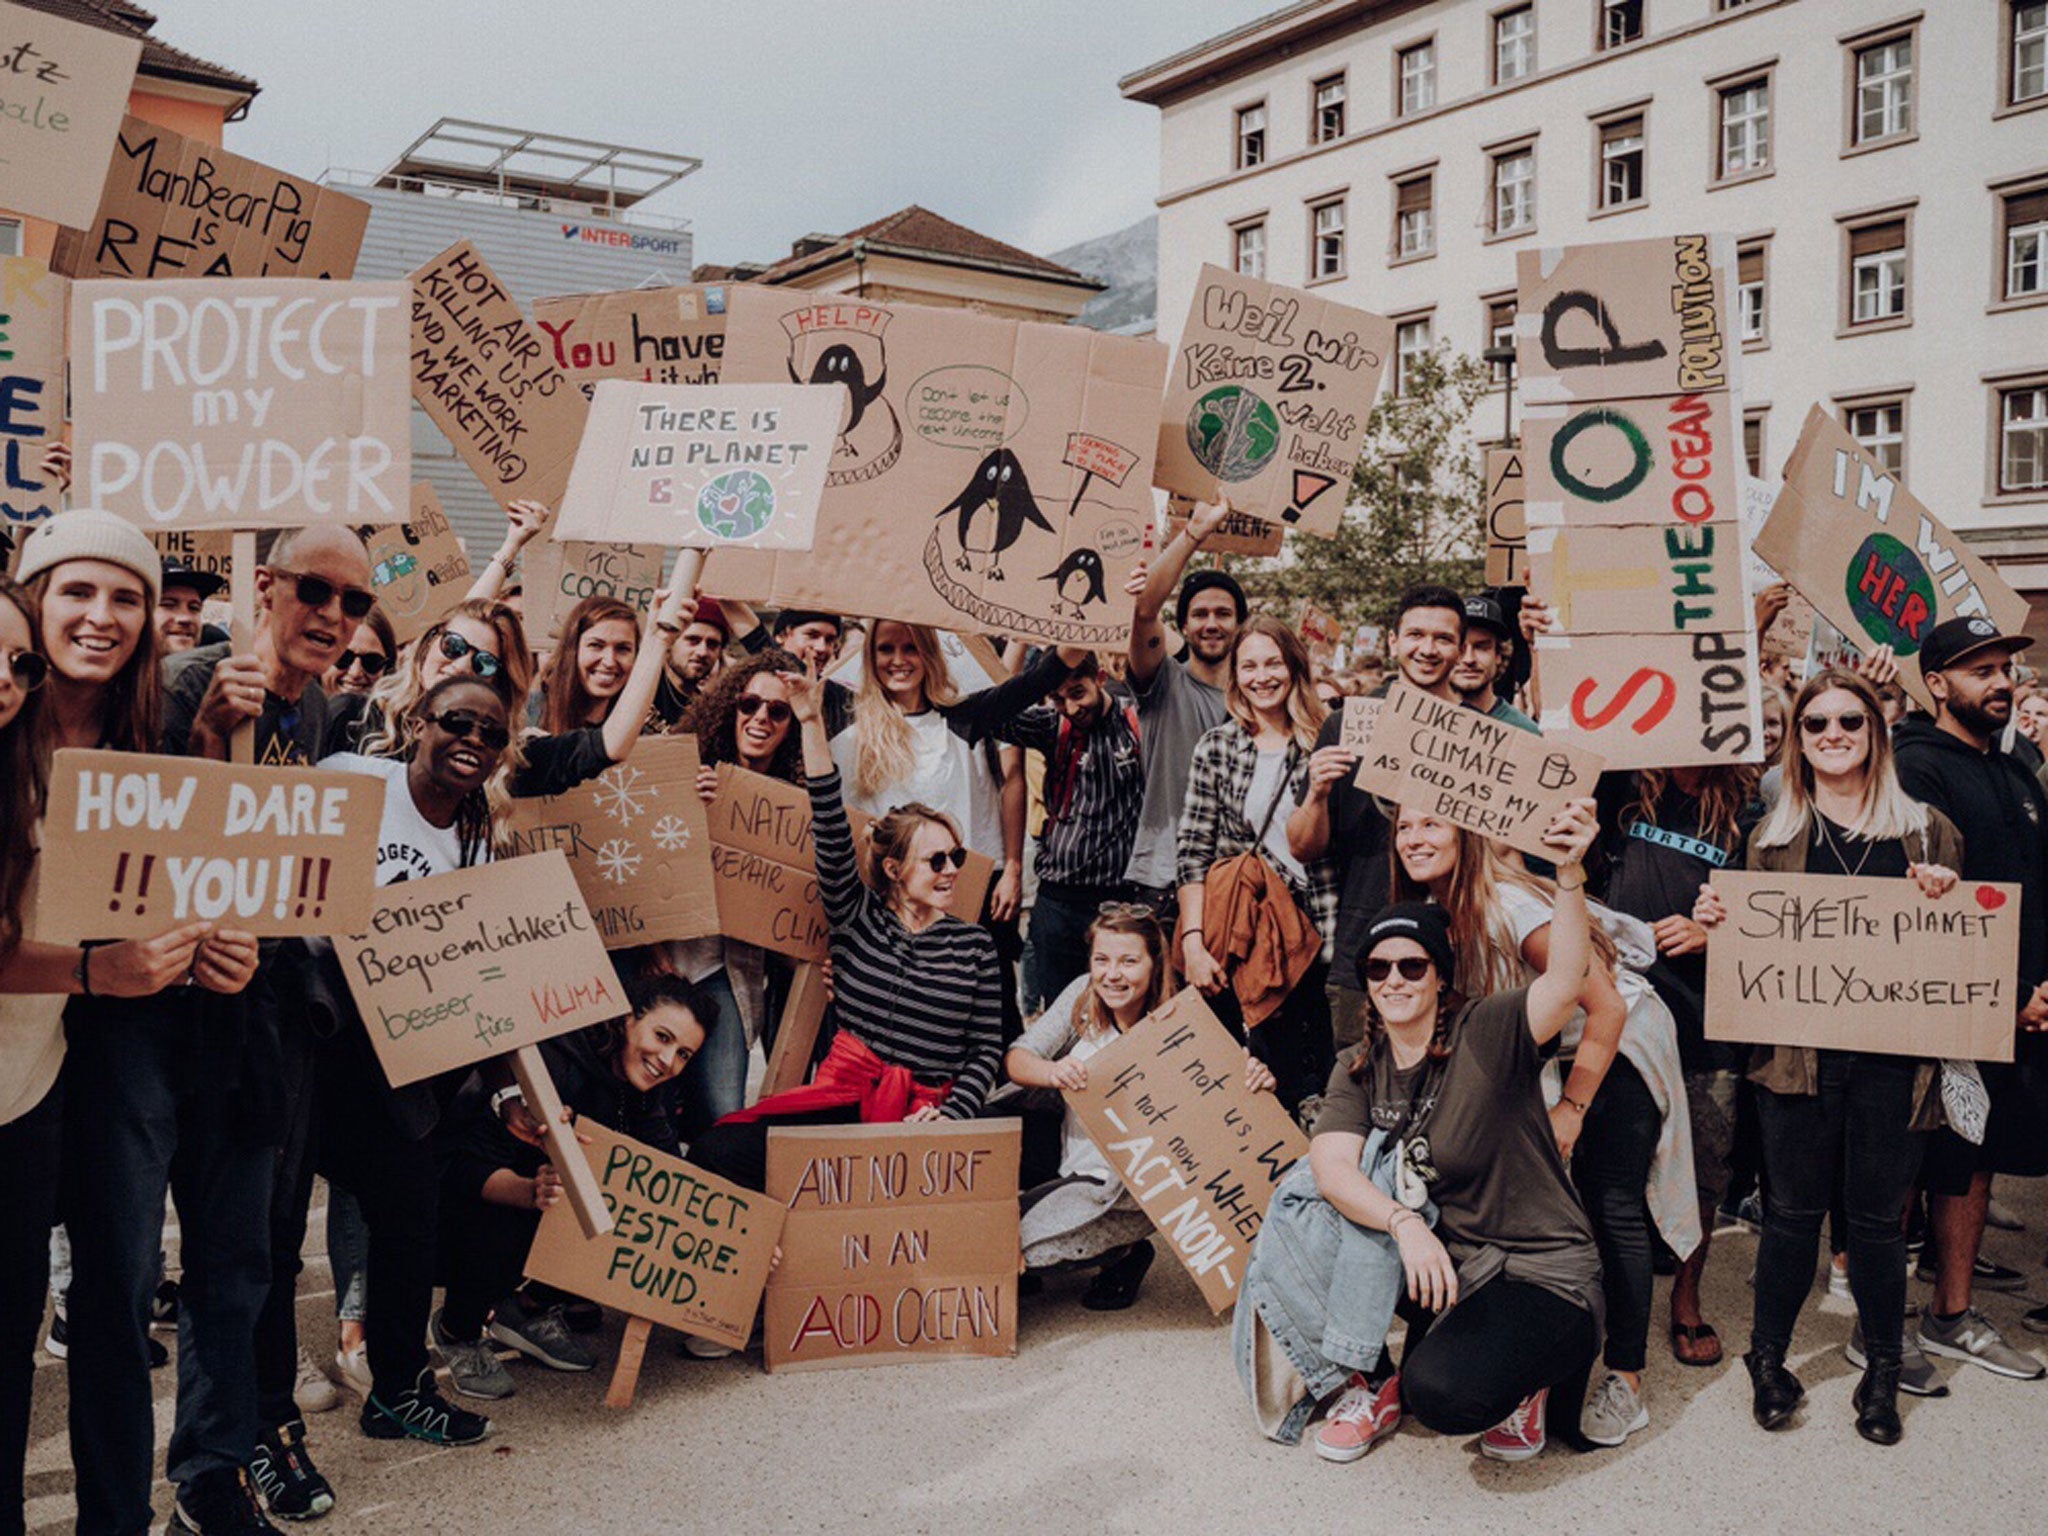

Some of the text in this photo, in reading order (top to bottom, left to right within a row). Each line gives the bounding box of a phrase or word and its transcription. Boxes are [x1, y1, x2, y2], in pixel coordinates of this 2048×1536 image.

[0, 96, 70, 132] ale
[581, 226, 680, 253] INTERSPORT
[92, 295, 400, 393] PROTECT
[421, 267, 500, 362] KILLING
[449, 250, 566, 397] HOT AIR IS
[537, 313, 726, 369] You have
[796, 306, 883, 329] HELP!
[444, 344, 483, 387] WE
[474, 379, 529, 444] WORK
[1278, 353, 1327, 392] 2.
[193, 387, 276, 428] my
[639, 405, 778, 433] THERE IS
[89, 436, 395, 522] POWDER
[631, 442, 809, 468] NO PLANET
[1833, 448, 1997, 628] I'M WIT
[1666, 526, 1715, 630] THE
[1857, 552, 1928, 641] HER
[1394, 691, 1508, 755] I LIKE MY
[1691, 631, 1752, 756] STOP
[1373, 754, 1539, 823] AS COLD AS MY
[1410, 729, 1517, 786] CLIMATE
[75, 770, 349, 837] HOW DARE
[1434, 792, 1513, 837] BEER!!
[711, 845, 786, 894] REPAIR
[350, 894, 472, 940] eniger
[1739, 890, 1840, 942] SAVE
[356, 901, 589, 994] Bequemlichkeit
[376, 992, 474, 1041] besser
[1156, 1025, 1195, 1057] If
[1182, 1058, 1231, 1097] not
[1105, 1063, 1145, 1099] If
[1135, 1093, 1179, 1126] not
[602, 1144, 749, 1234] PROTECT.
[868, 1152, 908, 1202] NO
[919, 1149, 992, 1198] SURF
[608, 1246, 706, 1307] FUND.
[842, 1230, 929, 1269] IN AN
[790, 1294, 882, 1352] ACID
[894, 1285, 998, 1348] OCEAN
